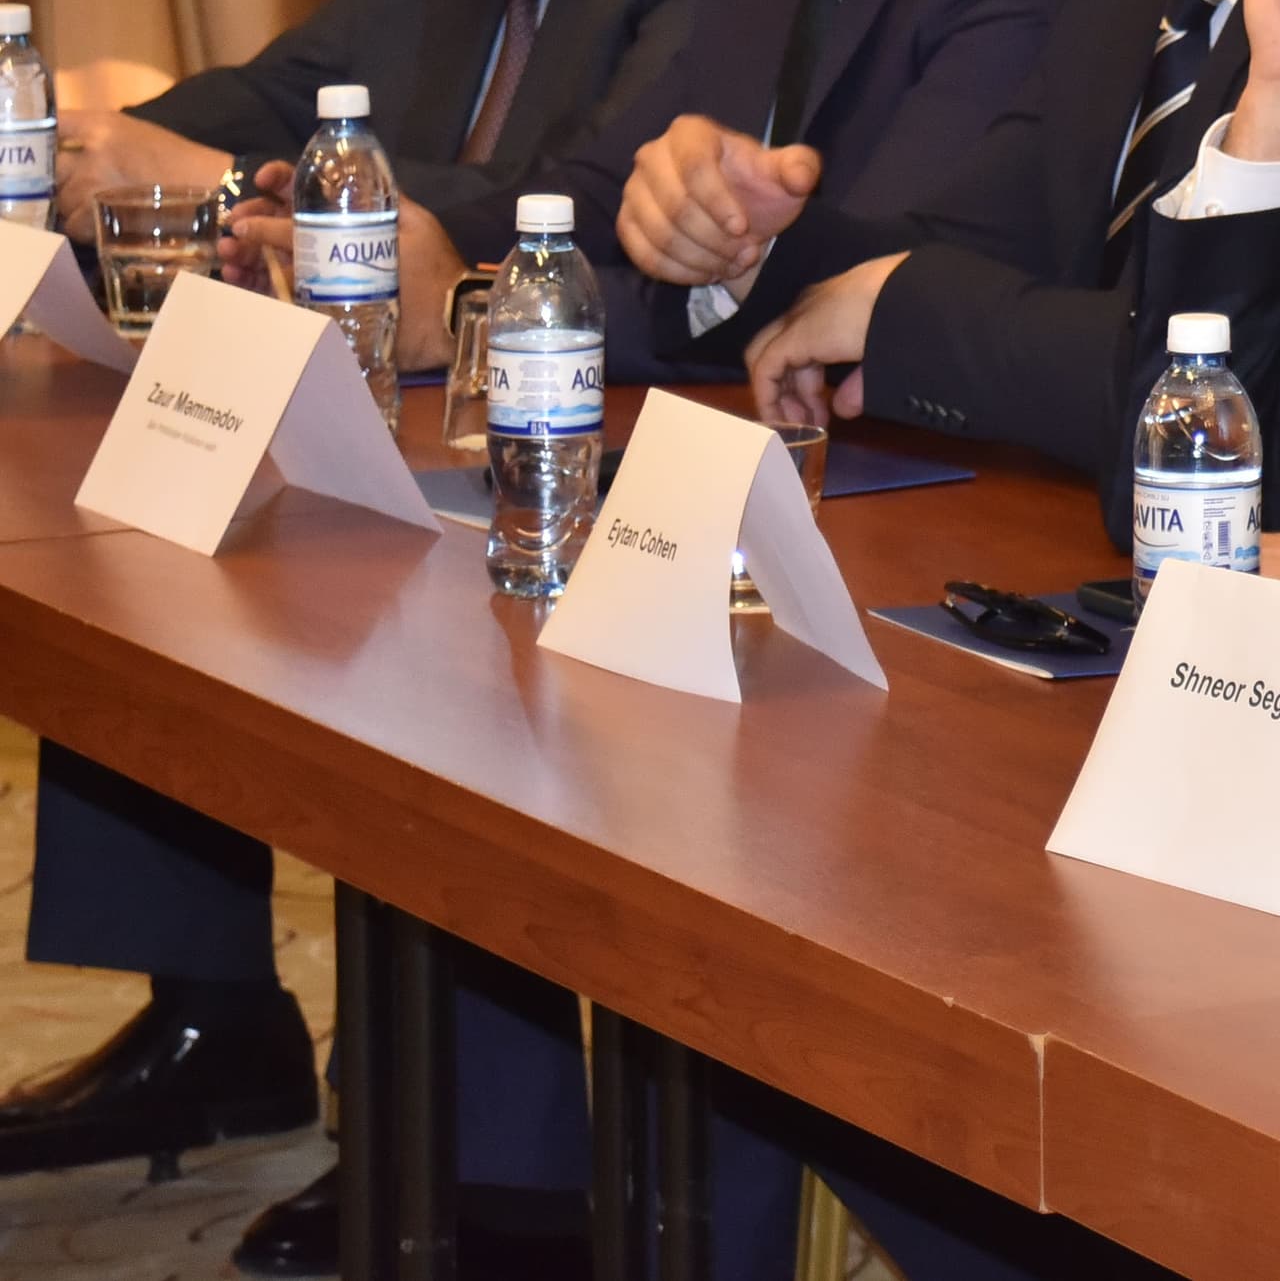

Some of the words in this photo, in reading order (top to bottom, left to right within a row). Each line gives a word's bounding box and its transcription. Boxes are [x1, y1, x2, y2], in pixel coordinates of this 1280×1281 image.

[608, 518, 639, 549] Eytan
[639, 527, 677, 561] Cohen
[1170, 662, 1247, 703] Shneor
